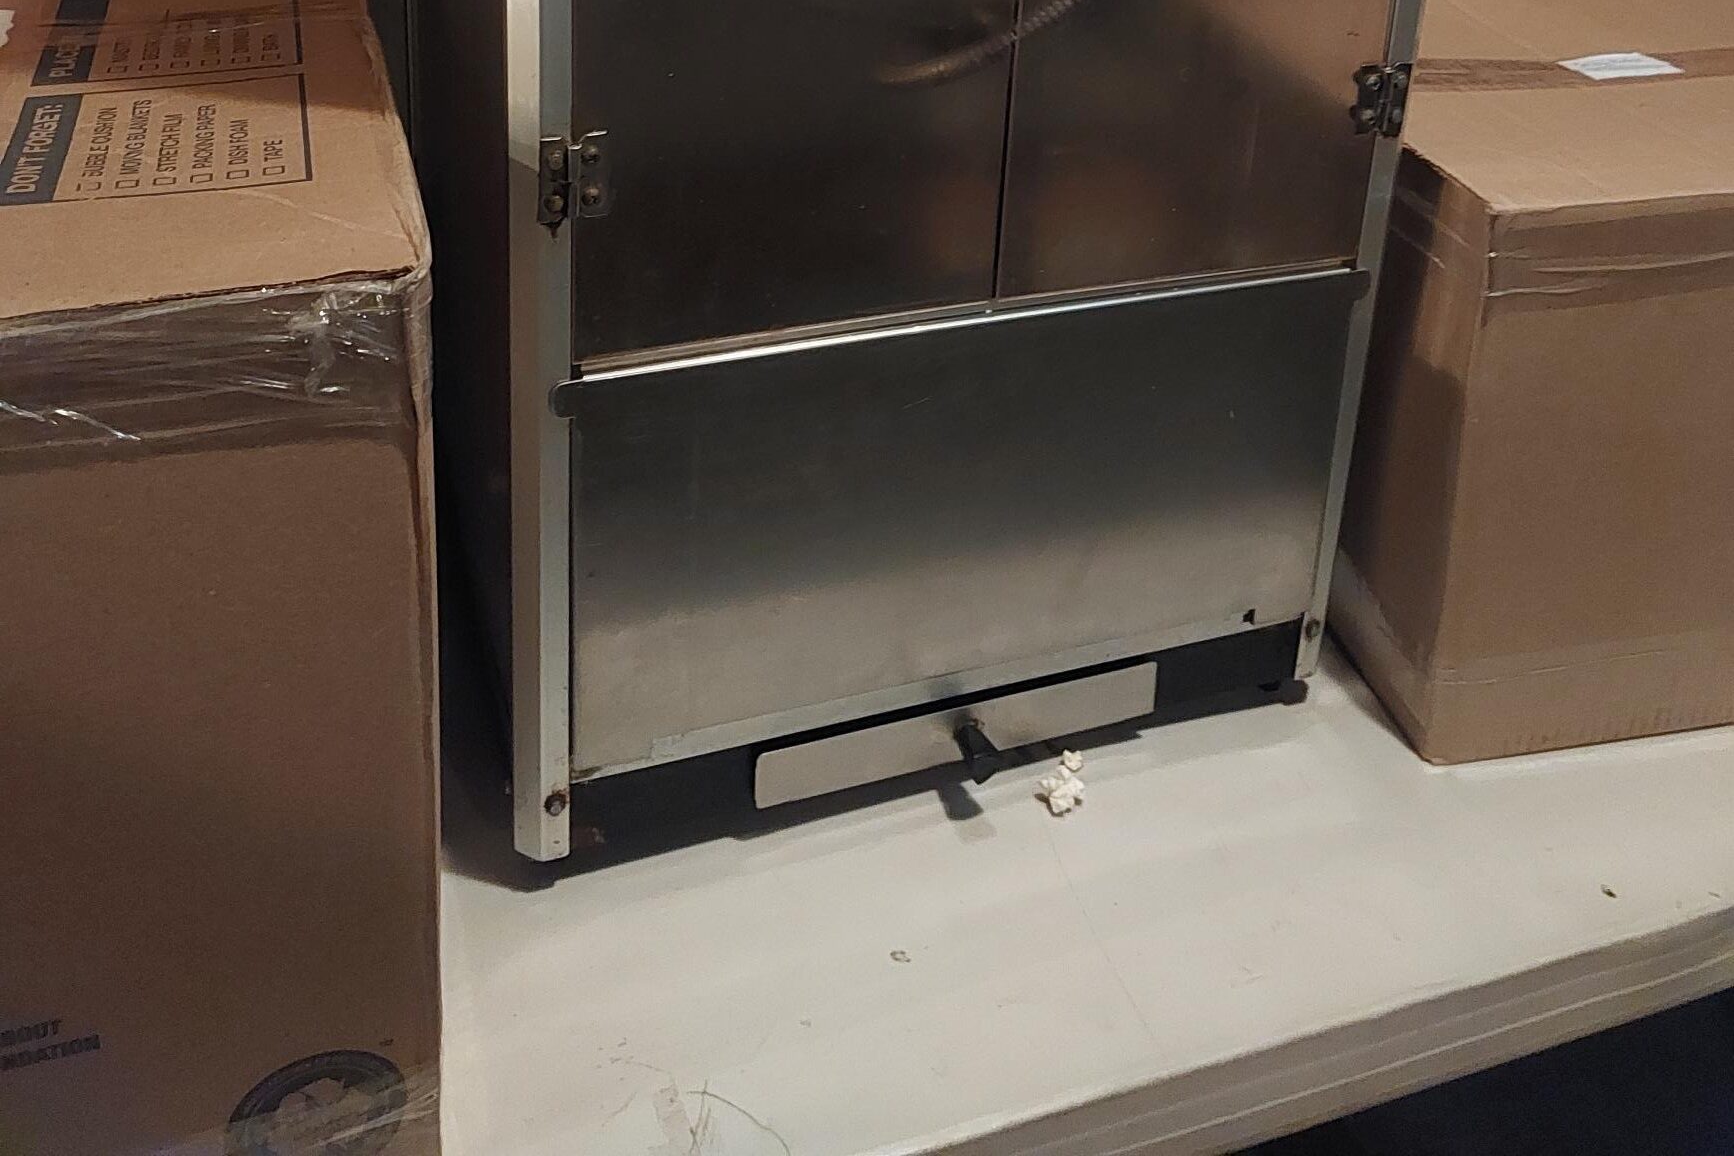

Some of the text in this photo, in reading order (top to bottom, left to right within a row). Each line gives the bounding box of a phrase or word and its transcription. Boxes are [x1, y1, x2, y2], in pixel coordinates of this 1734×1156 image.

[82, 107, 117, 177] BUBBLE CUSHION
[127, 99, 152, 142] BLANKETS
[156, 113, 183, 172] STRETCH FILM
[192, 104, 216, 169] PACKING PAPER
[228, 119, 249, 165] DISH FOAM
[263, 139, 283, 163] TAPE
